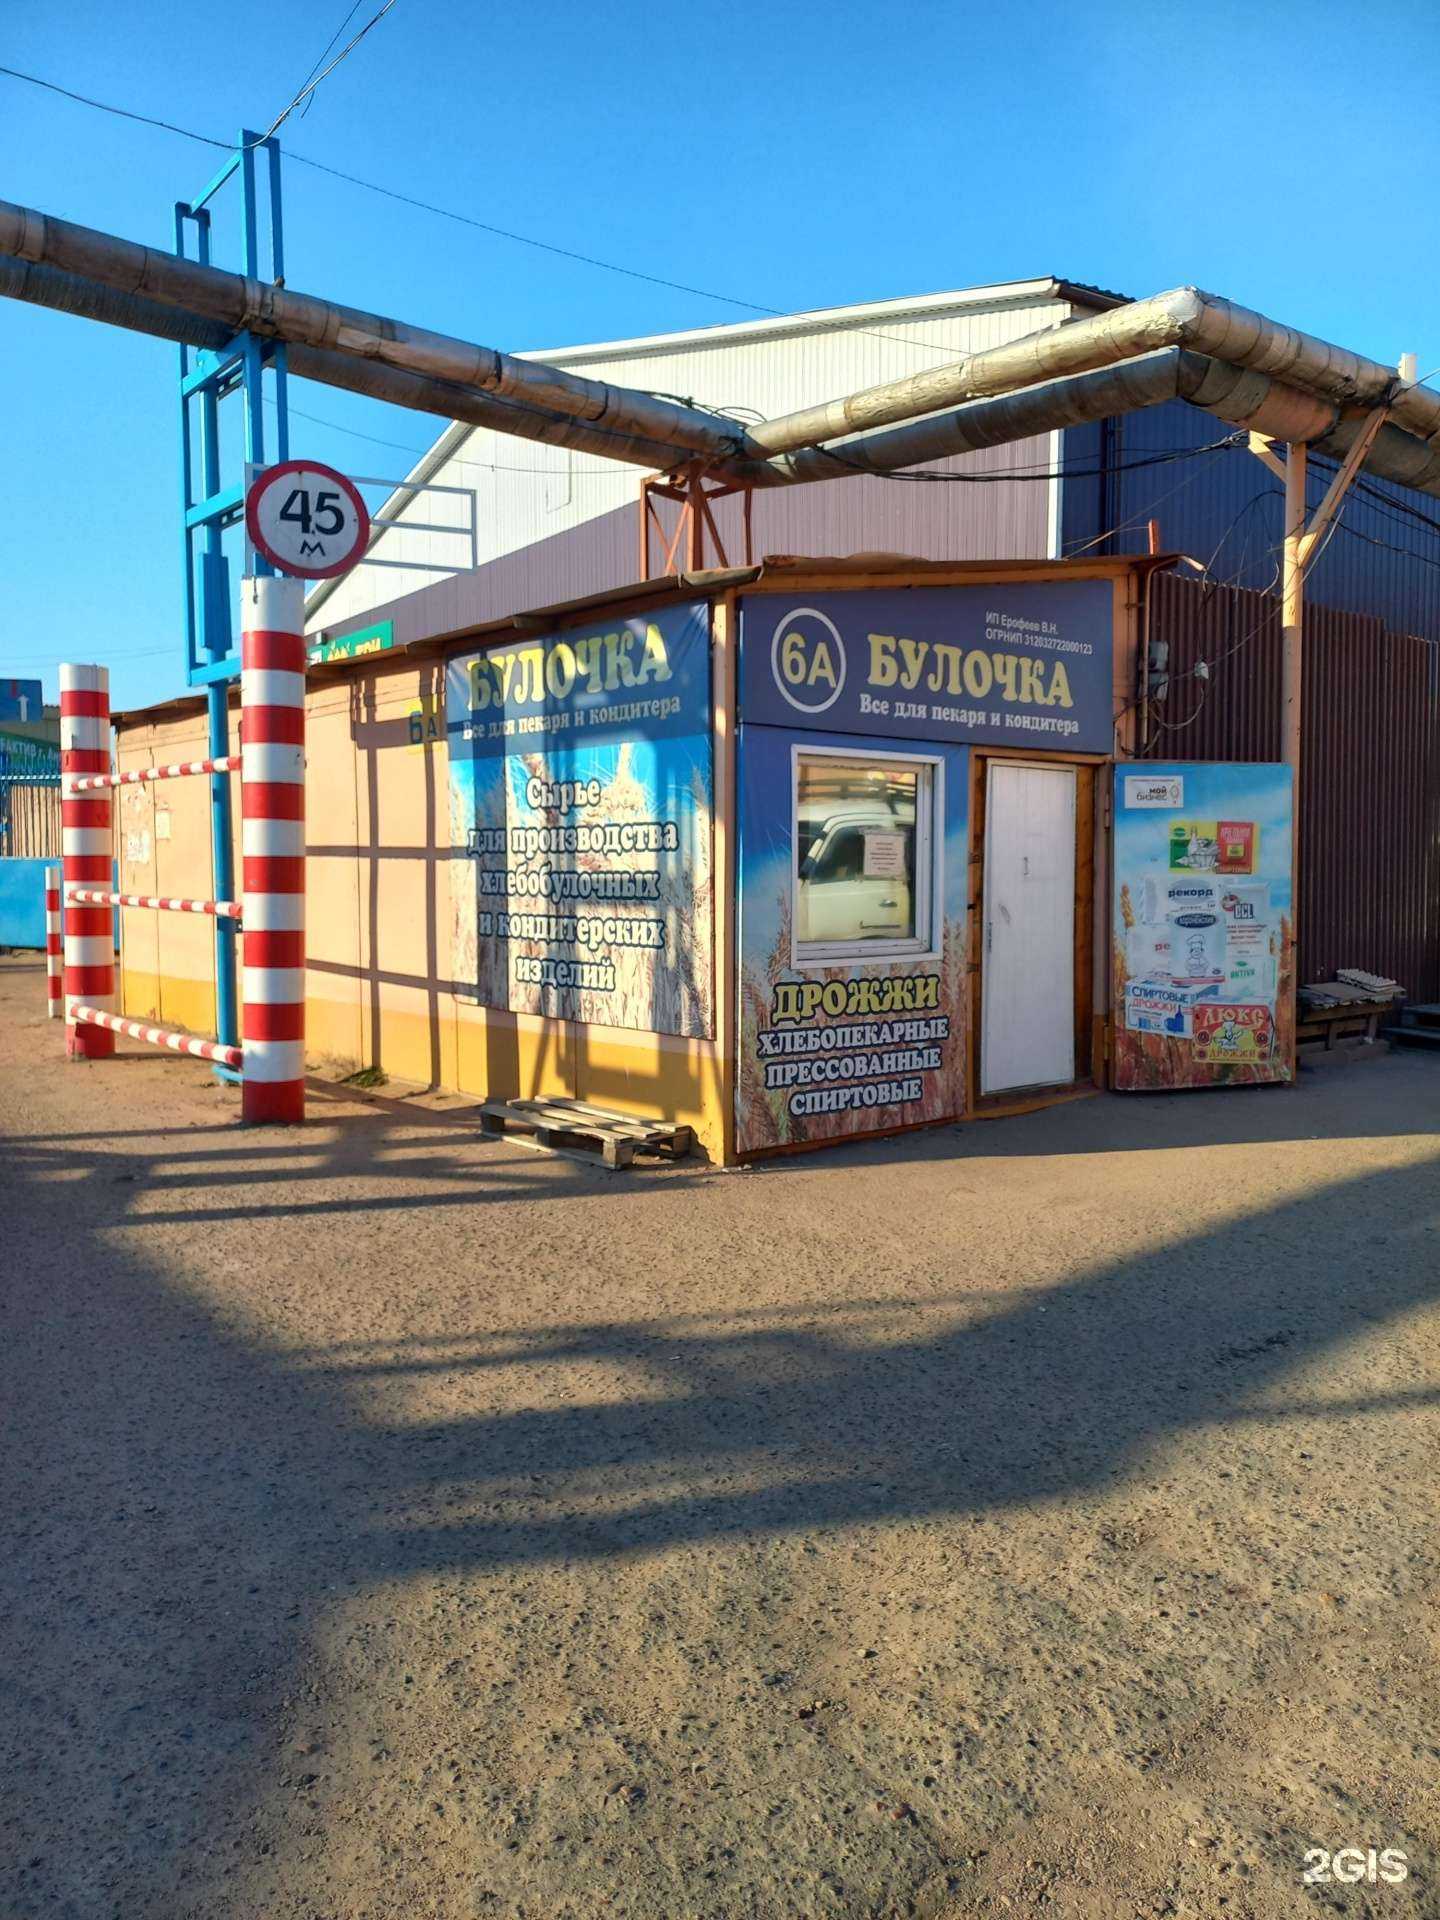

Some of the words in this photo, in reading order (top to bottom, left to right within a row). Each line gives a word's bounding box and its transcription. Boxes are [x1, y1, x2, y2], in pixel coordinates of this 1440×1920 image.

[985, 611, 999, 624] ИП
[985, 628, 1023, 645] ОГРНИП
[467, 624, 672, 711] БУЛОЧКА
[782, 633, 837, 688] 6А
[867, 633, 1074, 708] БУЛОЧКА
[462, 719, 486, 741] Все
[488, 718, 515, 738] для
[518, 711, 571, 734] пекаря
[574, 709, 585, 726] и
[589, 695, 681, 727] кондитера
[859, 693, 889, 715] Все
[894, 699, 927, 721] для
[931, 705, 986, 728] пекаря
[990, 711, 1001, 727] и
[1005, 713, 1080, 736] кондитера
[526, 777, 601, 815] Сырье
[467, 828, 506, 856] для
[511, 821, 678, 860] производства
[480, 861, 660, 904] хлебобулочных
[1168, 888, 1214, 898] рекорд
[478, 911, 493, 937] и
[497, 912, 665, 951] кондитерских
[515, 956, 616, 991] изделий
[771, 974, 940, 1026] ДРОЖЖИ
[1131, 986, 1189, 1003] СПИРТОВЫЕ
[757, 1016, 950, 1058] ХЛЕБОПЕКАРНЫЕ
[765, 1045, 943, 1089] ПРЕССОВАННЫЕ
[789, 1076, 923, 1116] СПИРТОВЫЕ
